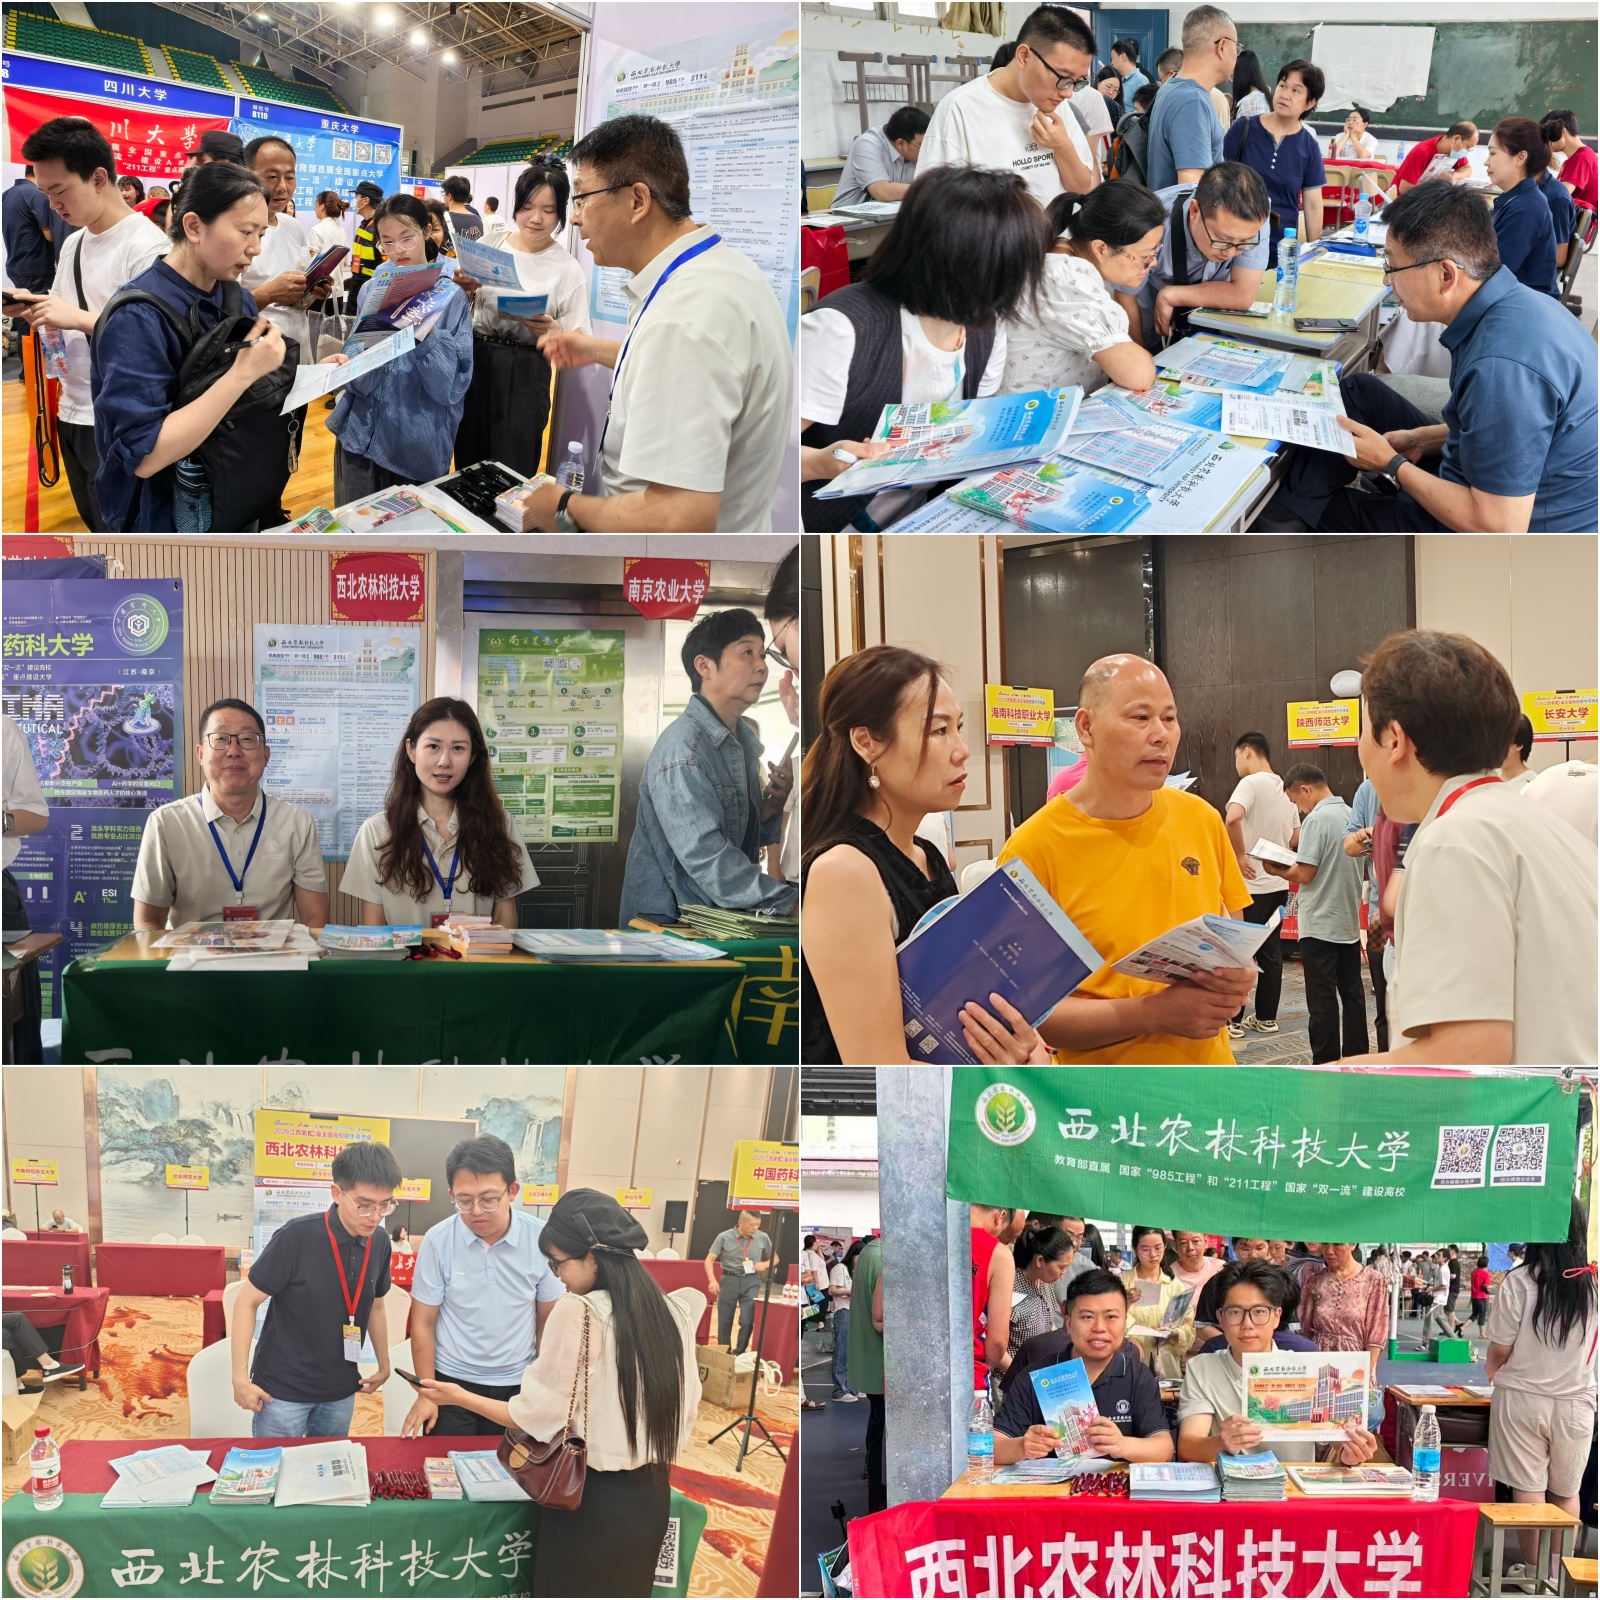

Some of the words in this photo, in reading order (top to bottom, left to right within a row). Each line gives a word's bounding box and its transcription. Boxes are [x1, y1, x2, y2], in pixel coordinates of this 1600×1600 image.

[104, 79, 167, 101] 四川大学
[252, 110, 268, 120] B119
[320, 118, 359, 134] 重庆大学
[1012, 156, 1032, 167] HOLLO
[336, 573, 420, 601] 西北农林科技大学
[628, 577, 705, 604] 南京农业大学
[3, 632, 94, 657] 药科大学
[13, 673, 53, 681] 重点建设大学
[991, 706, 1051, 722] 海南科技职业大学
[1544, 706, 1589, 719] 长安大学
[1296, 715, 1350, 728] 陕西师范大学
[101, 888, 117, 897] ESI
[1058, 1107, 1410, 1173] 西北农林科技大学
[753, 1166, 799, 1182] 中国药科
[1053, 1153, 1111, 1174] 教育部直属
[1119, 1164, 1142, 1178] 国家
[1147, 1166, 1202, 1185] “985工程”
[1207, 1175, 1218, 1186] 和
[1224, 1176, 1278, 1192] “211工程”
[1285, 1181, 1307, 1194] 国家
[1312, 1182, 1357, 1197] “双一流”
[1362, 1186, 1405, 1198] 建设高校
[111, 1530, 534, 1593] 西北农林科技大学
[904, 1528, 1424, 1598] 西北农林科技大学
